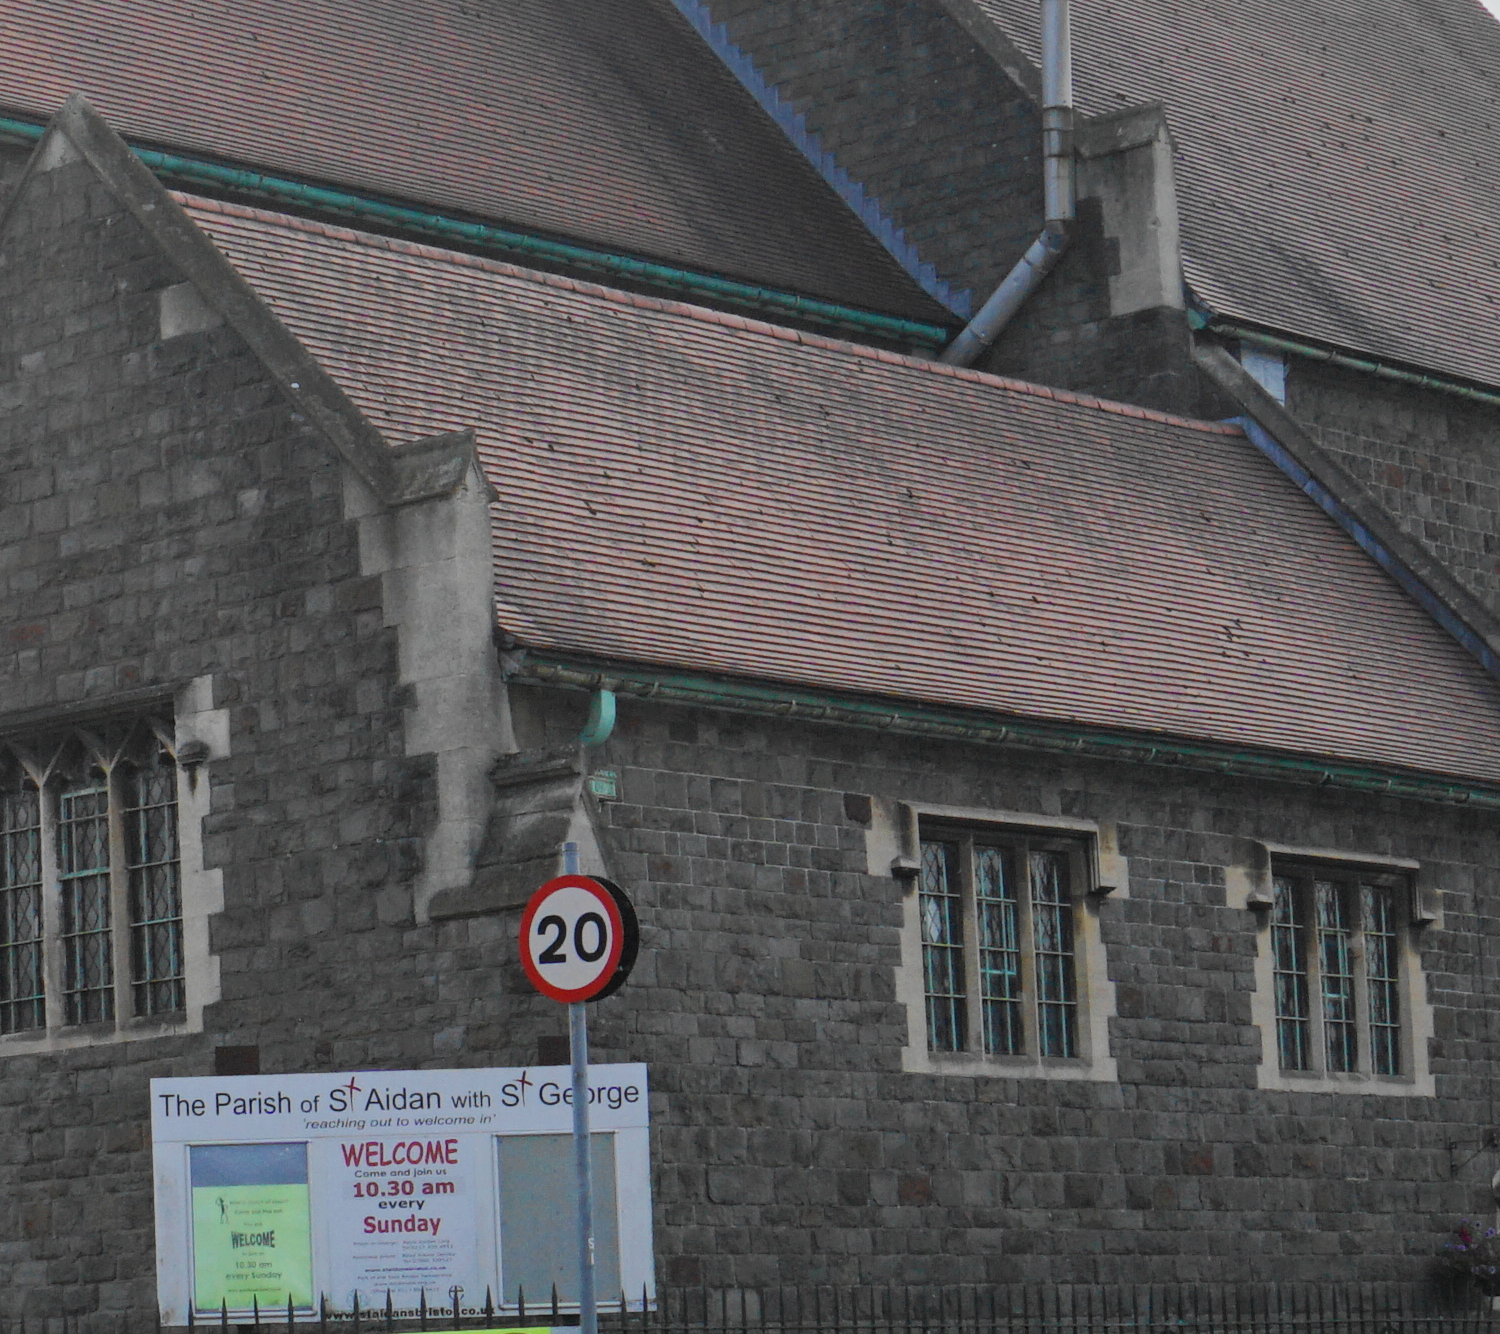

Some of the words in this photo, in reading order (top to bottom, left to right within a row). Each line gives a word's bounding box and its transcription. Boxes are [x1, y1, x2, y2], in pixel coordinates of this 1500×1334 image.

[537, 912, 608, 964] 20
[159, 1094, 205, 1117] The
[215, 1091, 291, 1115] Parish
[301, 1095, 320, 1113] of
[365, 1087, 441, 1111] Aidan
[451, 1090, 491, 1108] with
[370, 1118, 392, 1128] out
[397, 1117, 410, 1127] to
[414, 1115, 475, 1126] welcome
[341, 1139, 458, 1167] WELCOME
[355, 1170, 387, 1178] Come
[390, 1168, 411, 1177] and
[413, 1167, 433, 1178] join
[353, 1180, 414, 1197] 10.30
[422, 1181, 454, 1195] am
[378, 1200, 425, 1210] every
[364, 1214, 441, 1236] Sunday
[231, 1230, 275, 1249] WELCOME
